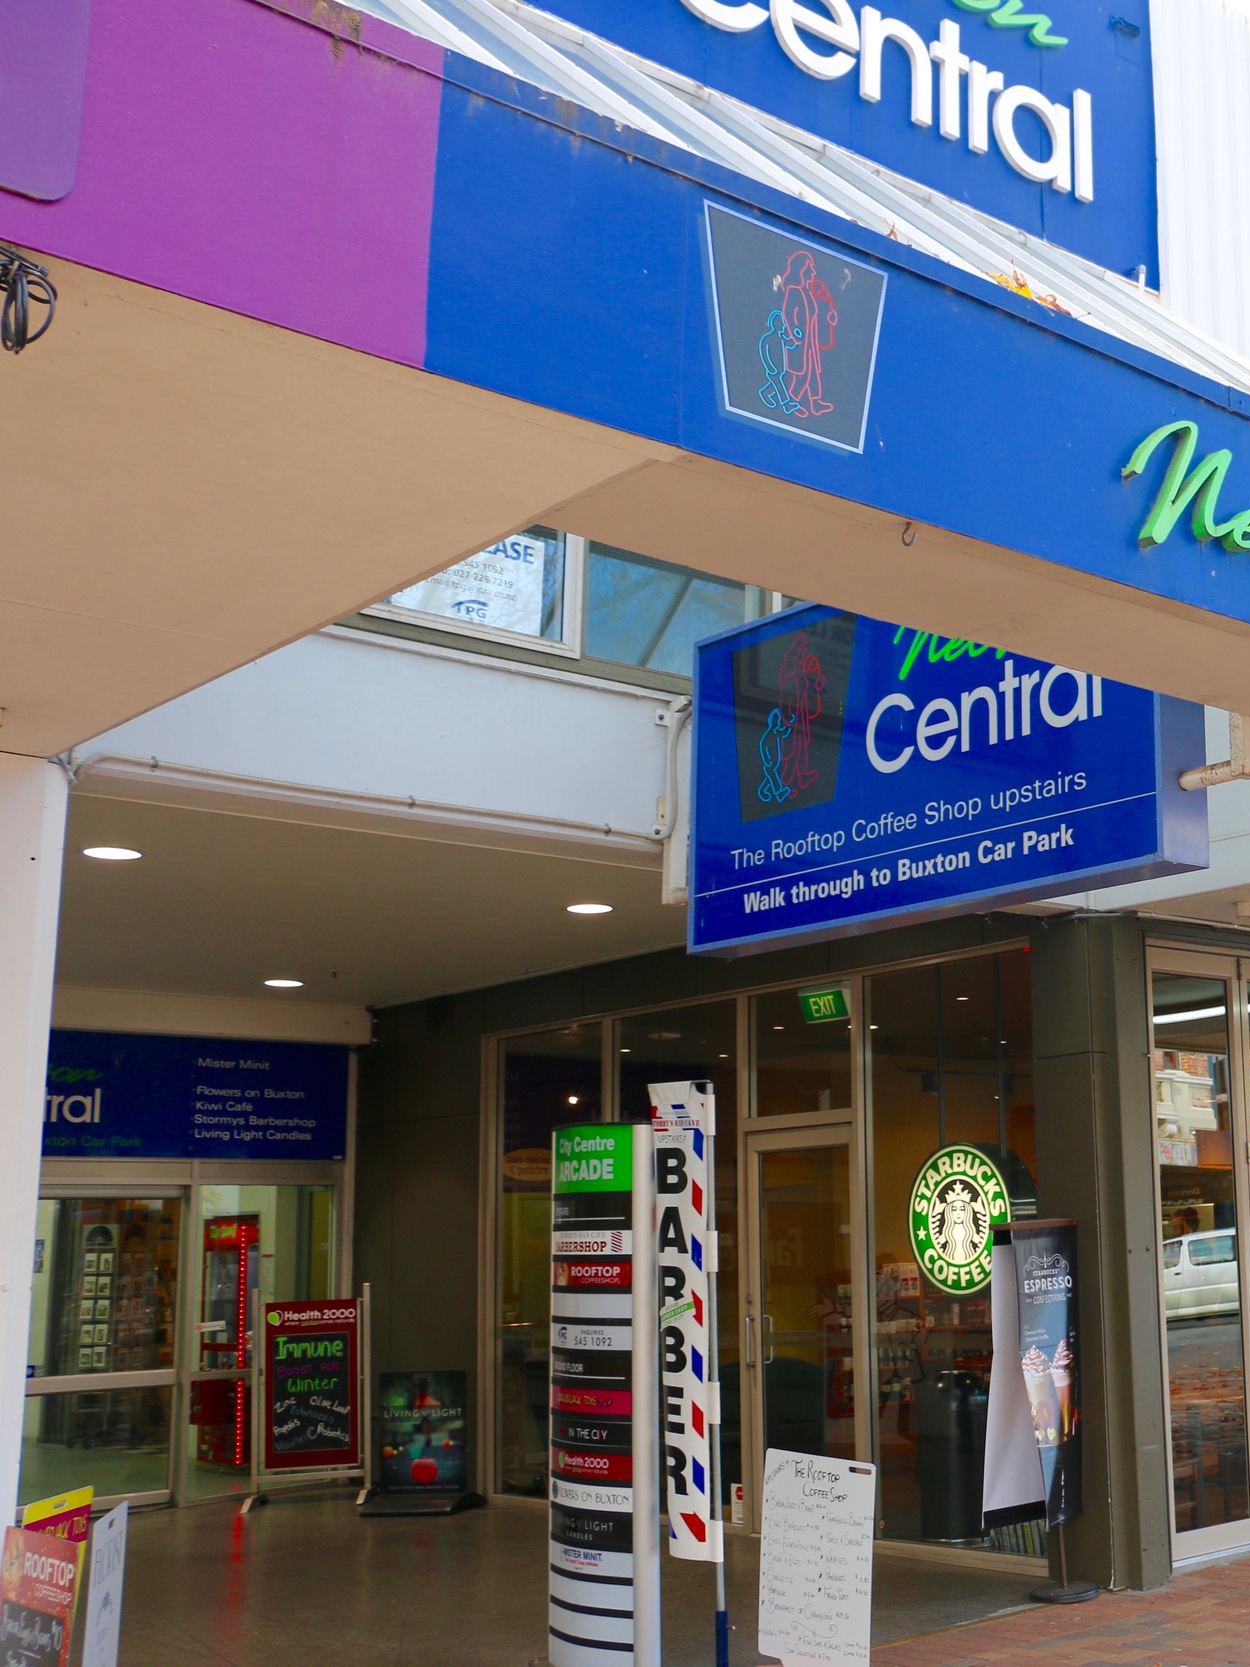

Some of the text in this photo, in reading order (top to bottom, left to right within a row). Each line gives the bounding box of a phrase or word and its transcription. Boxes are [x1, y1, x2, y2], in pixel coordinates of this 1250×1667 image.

[678, 0, 1093, 202] entral
[482, 540, 535, 565] ASE
[866, 659, 1103, 774] Central
[731, 769, 1088, 871] The Rooftop Coffee Shop upstairs
[743, 823, 1075, 914] Walk through to Buxton Car Park
[809, 995, 836, 1017] EXIT
[198, 1058, 270, 1070] Mister Minit
[196, 1085, 305, 1099] Flowers on Buxton
[196, 1101, 222, 1111] Kiwi
[194, 1114, 316, 1129] Stormys Barbershop
[111, 1135, 143, 1147] Park
[194, 1129, 312, 1141] Living Light Candles
[560, 1136, 615, 1157] City Centre
[559, 1158, 615, 1183] ARCADE
[914, 1152, 1006, 1217] STARBUCKS
[556, 1240, 607, 1253] BARBERSHOP
[570, 1266, 621, 1277] ROOFTOP
[923, 1248, 992, 1288] COFFEE
[1023, 1275, 1073, 1294] ESPRESSO
[1033, 1293, 1067, 1305] CONFECTIONS
[284, 1308, 356, 1321] Health 2000
[275, 1336, 344, 1360] Immune
[574, 1336, 612, 1347] 545 1092
[567, 1363, 584, 1373] FLOOR
[287, 1377, 338, 1393] Winter
[274, 1397, 297, 1413] Zinc
[310, 1396, 331, 1409] Olive
[384, 1408, 462, 1418] LIVING LIGHT
[307, 1426, 318, 1440] C
[576, 1427, 590, 1439] THE
[564, 1453, 609, 1469] Health 2000
[791, 1459, 841, 1484] THE ROOFTOP
[581, 1491, 592, 1502] ON
[595, 1492, 630, 1506] BUXTON
[802, 1481, 830, 1500] COFFEE
[830, 1486, 848, 1503] SHOP
[584, 1521, 614, 1532] LIGHT
[566, 1530, 593, 1541] CANDLES
[23, 1552, 74, 1588] ROOFTOP
[34, 1583, 73, 1604] COFFEESHOP
